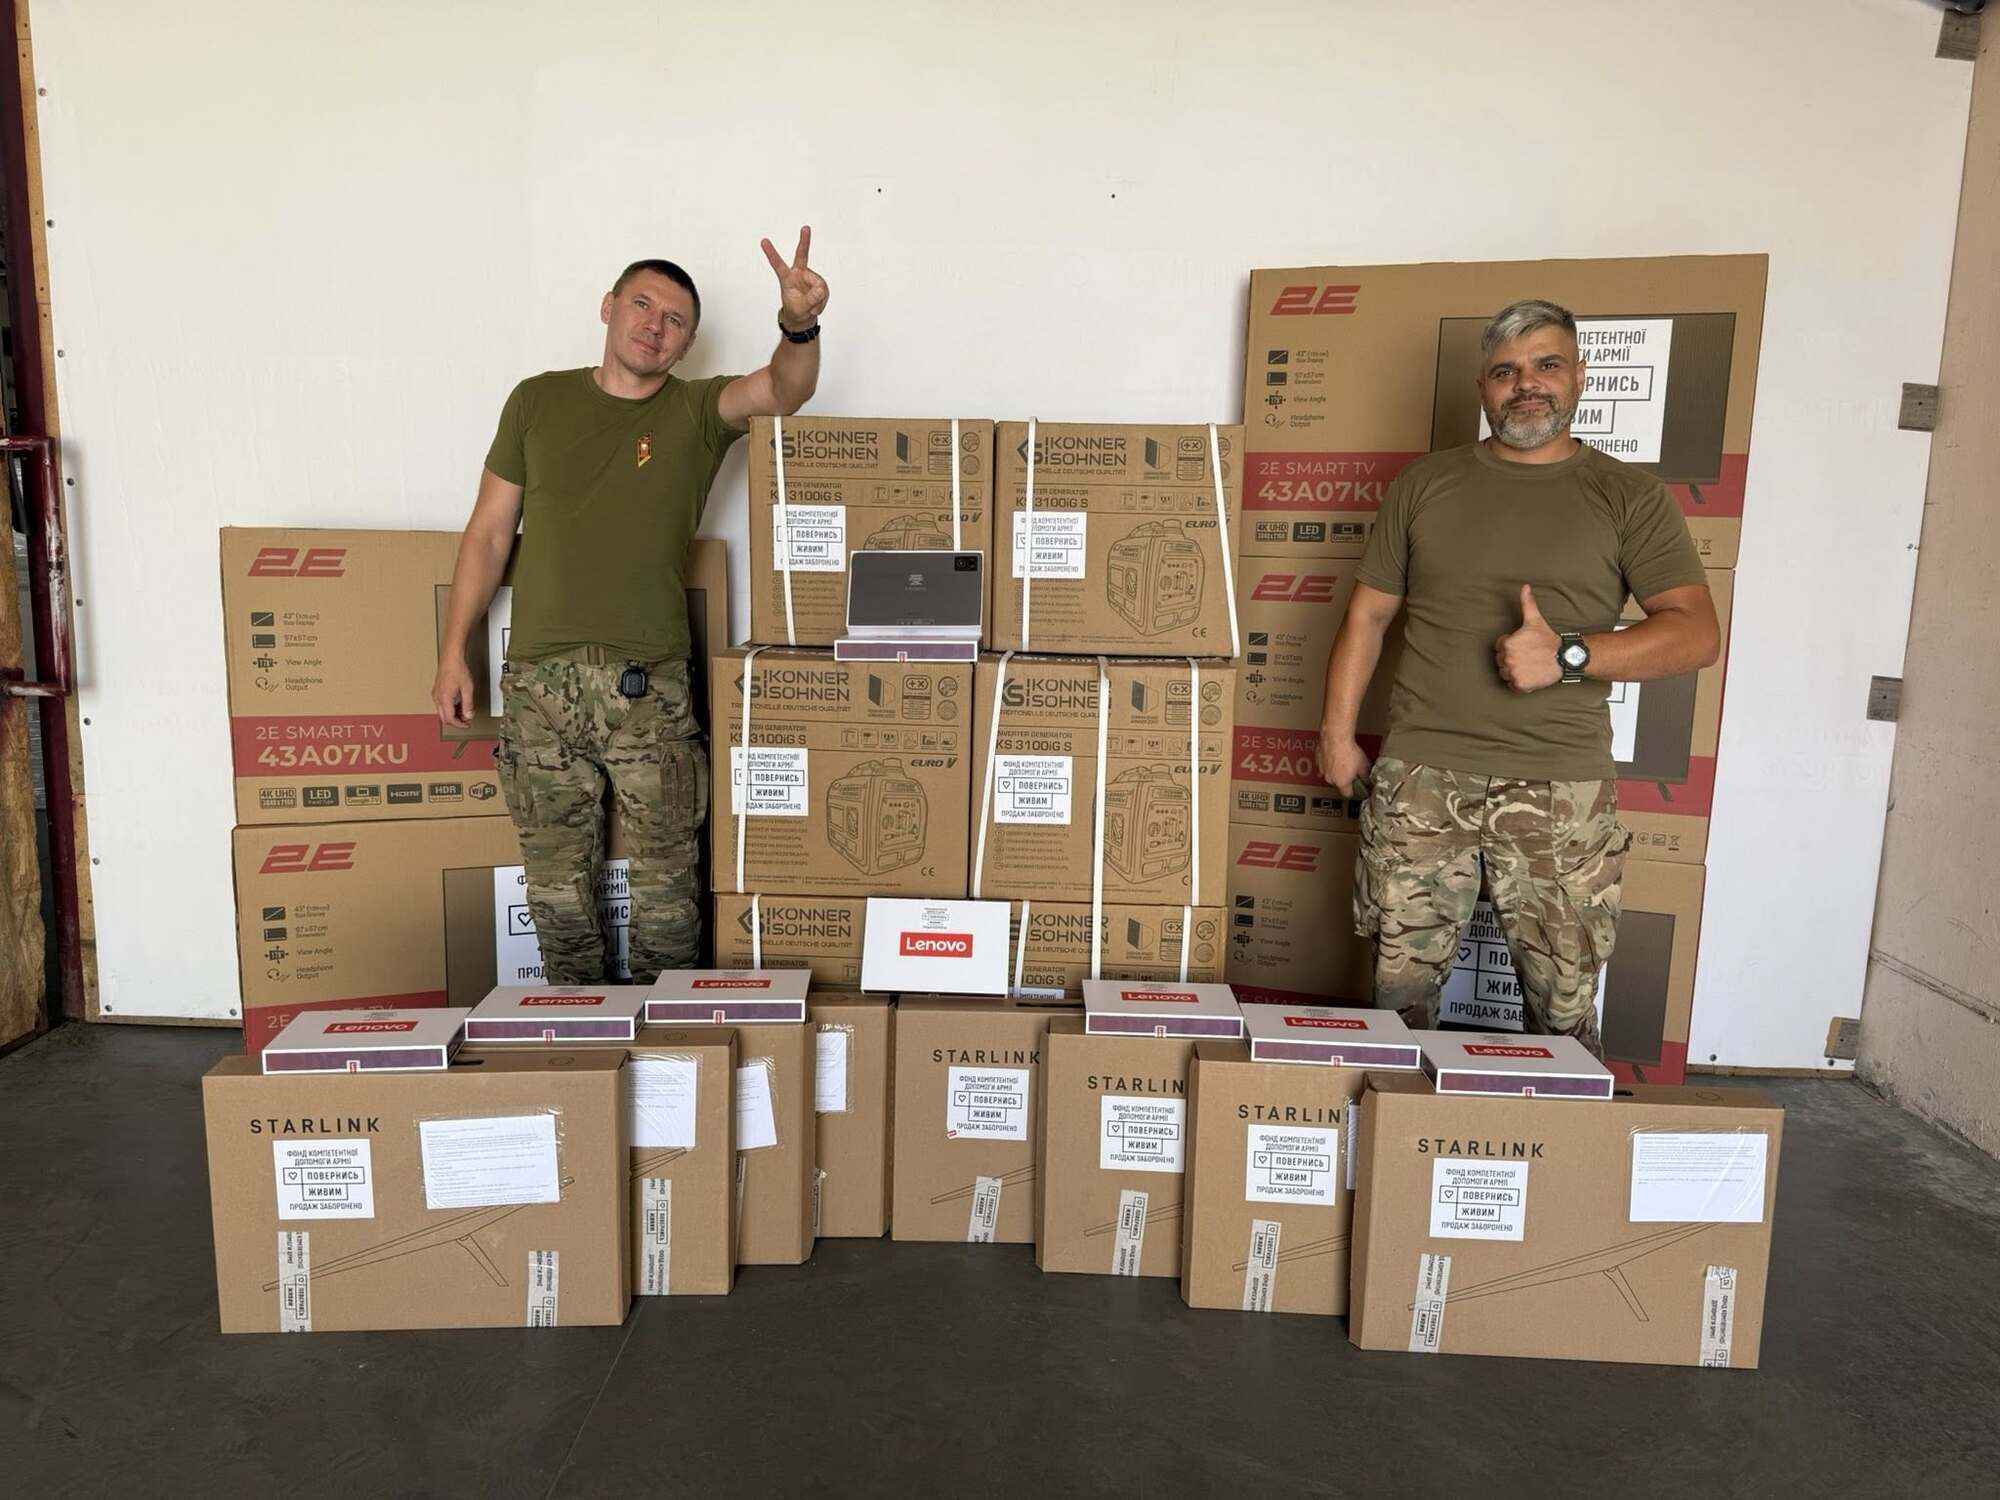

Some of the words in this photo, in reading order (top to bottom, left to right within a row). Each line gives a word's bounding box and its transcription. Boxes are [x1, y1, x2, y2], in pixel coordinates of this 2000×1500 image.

[1269, 285, 1361, 316] 2E
[1578, 329, 1647, 345] ПЕТЕНТНОЇ
[1593, 346, 1632, 362] АРМІЇ
[1585, 376, 1639, 391] РНИСЬ
[802, 430, 878, 444] KONNER
[1051, 436, 1126, 450] KONNER
[1590, 439, 1638, 453] РОНЕНО
[803, 446, 878, 460] SOHNEN
[1052, 453, 1126, 466] SOHNEN
[1259, 462, 1280, 475] 2E
[1286, 462, 1349, 475] SMART
[1353, 462, 1376, 475] TV
[834, 491, 842, 501] S
[1080, 499, 1088, 508] S
[1185, 520, 1217, 528] EURO
[796, 530, 838, 539] ПОВЕРНИСЬ
[1300, 525, 1319, 534] LED
[1035, 537, 1078, 545] ПОВЕРНИСЬ
[796, 545, 824, 553] ЖИВИМ
[1035, 552, 1063, 560] ЖИВИМ
[248, 548, 347, 577] 2E
[1251, 575, 1338, 603] 2E
[769, 670, 850, 685] KONNER
[770, 686, 850, 701] SOHNEN
[256, 726, 280, 740] 2E
[286, 725, 354, 739] SMART
[360, 725, 384, 738] TV
[751, 734, 795, 744] 3100iG
[798, 735, 806, 744] S
[1241, 735, 1261, 749] 2E
[1266, 736, 1316, 752] SMAR
[1016, 741, 1060, 751] 3100iG
[1064, 742, 1072, 752] S
[257, 743, 409, 767] 43A07KU
[946, 757, 958, 768] V
[1240, 753, 1313, 776] 43A0
[1210, 764, 1221, 775] V
[755, 773, 799, 782] ПОВЕРНИСЬ
[434, 785, 457, 795] HDR
[1019, 781, 1063, 790] ПОВЕРНИСЬ
[309, 789, 330, 800] LED
[1280, 797, 1299, 807] LED
[259, 842, 357, 874] 2E
[1236, 841, 1321, 873] 2E
[772, 908, 851, 922] KONNER
[772, 923, 851, 937] SOHNEN
[1469, 925, 1504, 939] ДОПО
[906, 937, 967, 952] Lenovo
[1057, 976, 1065, 985] S
[1487, 980, 1522, 997] ЖИВ
[1127, 993, 1191, 1001] Lenovo
[1450, 1001, 1500, 1019] ПРОДАЖ
[333, 1023, 408, 1032] Lenovo
[1291, 1018, 1360, 1028] Lenovo
[1471, 1046, 1543, 1056] Lenovo
[932, 1049, 1040, 1064] STARLINK
[959, 1075, 976, 1083] ФОНД
[1087, 1076, 1184, 1094] STARLIN
[974, 1095, 1017, 1105] ПОВЕРНИСЬ
[973, 1110, 1001, 1118] ЖИВИМ
[1237, 1104, 1348, 1124] STARLIN
[250, 1117, 379, 1134] STARLINK
[956, 1122, 980, 1130] ПРОДАЖ
[981, 1124, 1018, 1132] ЗАБОРОНЕНО
[1128, 1126, 1173, 1135] ПОВЕРНИСЬ
[1259, 1134, 1278, 1143] ФОНД
[1279, 1136, 1326, 1145] КОМПЕТЕНТНОЇ
[1128, 1141, 1157, 1149] ЖИВИМ
[1265, 1143, 1300, 1151] ДОПОМОГИ
[1418, 1138, 1544, 1158] STARLINK
[309, 1148, 358, 1156] КОМПЕТЕНТНОЇ
[295, 1158, 331, 1166] ДОПОМОГИ
[1110, 1154, 1135, 1162] ПРОДАЖ
[1136, 1155, 1174, 1163] ЗАБОРОНЕНО
[1276, 1156, 1324, 1167] ПОВЕРНИСЬ
[307, 1171, 359, 1180] ПОВЕРНИСЬ
[1275, 1172, 1307, 1182] ЖИВИМ
[1445, 1169, 1465, 1177] ФОНД
[1467, 1170, 1516, 1178] КОМПЕТЕНТНОЇ
[1452, 1177, 1488, 1185] ДОПОМОГИ
[308, 1187, 342, 1196] ЖИВИМ
[1256, 1186, 1282, 1194] ПРОДАЖ
[1284, 1187, 1325, 1196] ЗАБОРОНЕНО
[1463, 1191, 1513, 1201] ПОВЕРНИСЬ
[290, 1202, 318, 1210] ПРОДАЖ
[320, 1202, 362, 1210] ЗАБОРОНЕНО
[1461, 1208, 1495, 1216] ЖИВИМ
[1441, 1221, 1470, 1230] ПРОДАЖ
[1471, 1222, 1513, 1231] ЗАБОРОНЕНО
